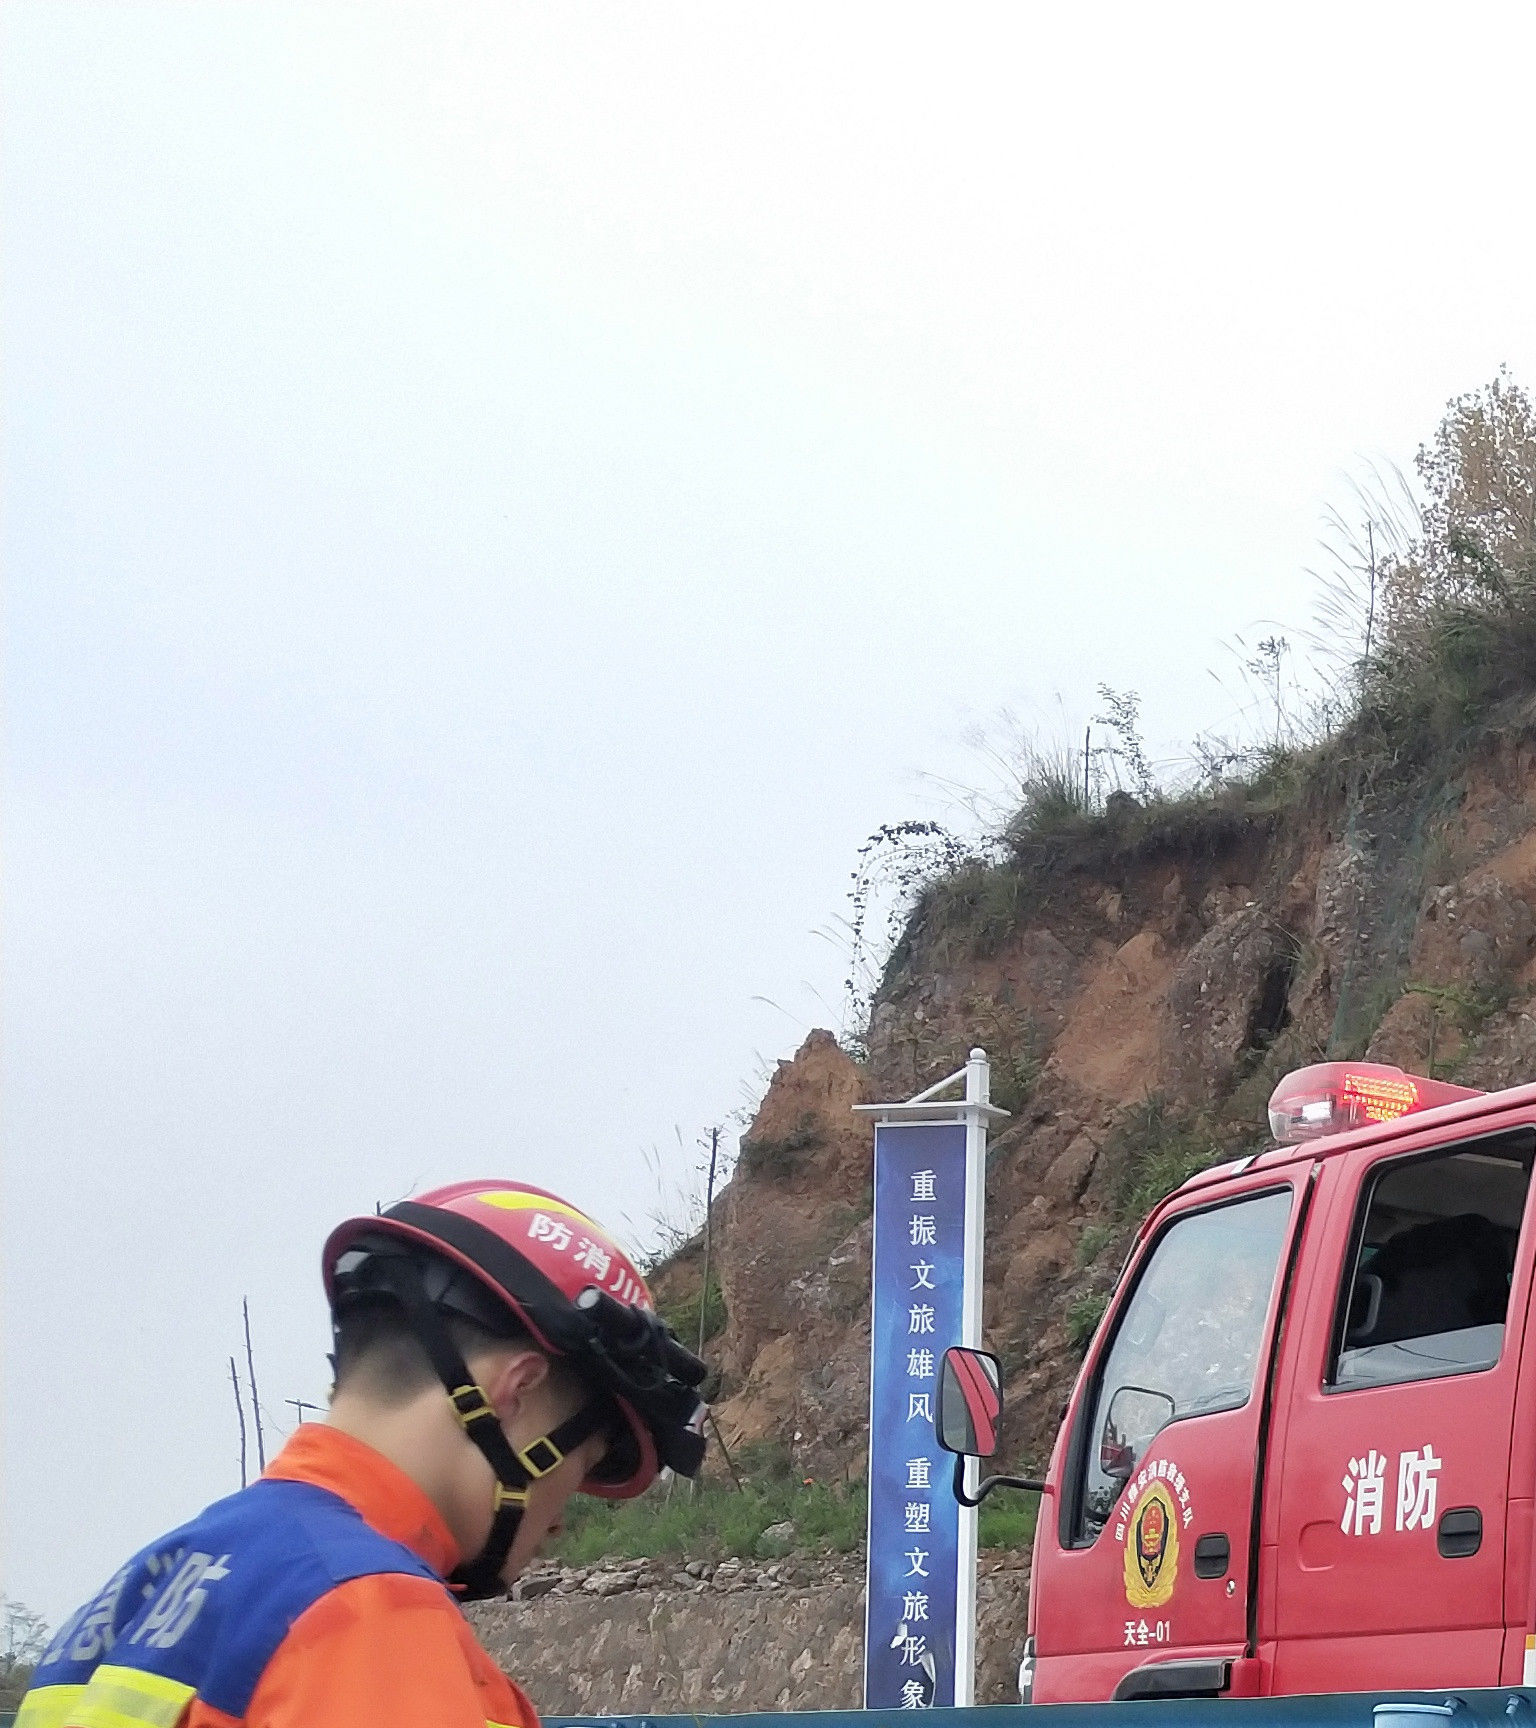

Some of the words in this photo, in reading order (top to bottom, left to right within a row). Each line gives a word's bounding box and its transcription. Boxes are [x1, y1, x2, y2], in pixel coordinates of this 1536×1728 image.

[906, 1169, 938, 1424] 重振文旅雄风
[1340, 1443, 1442, 1536] 消防
[900, 1456, 933, 1708] 重塑文旅形象
[1123, 1618, 1171, 1647] 天全-01
